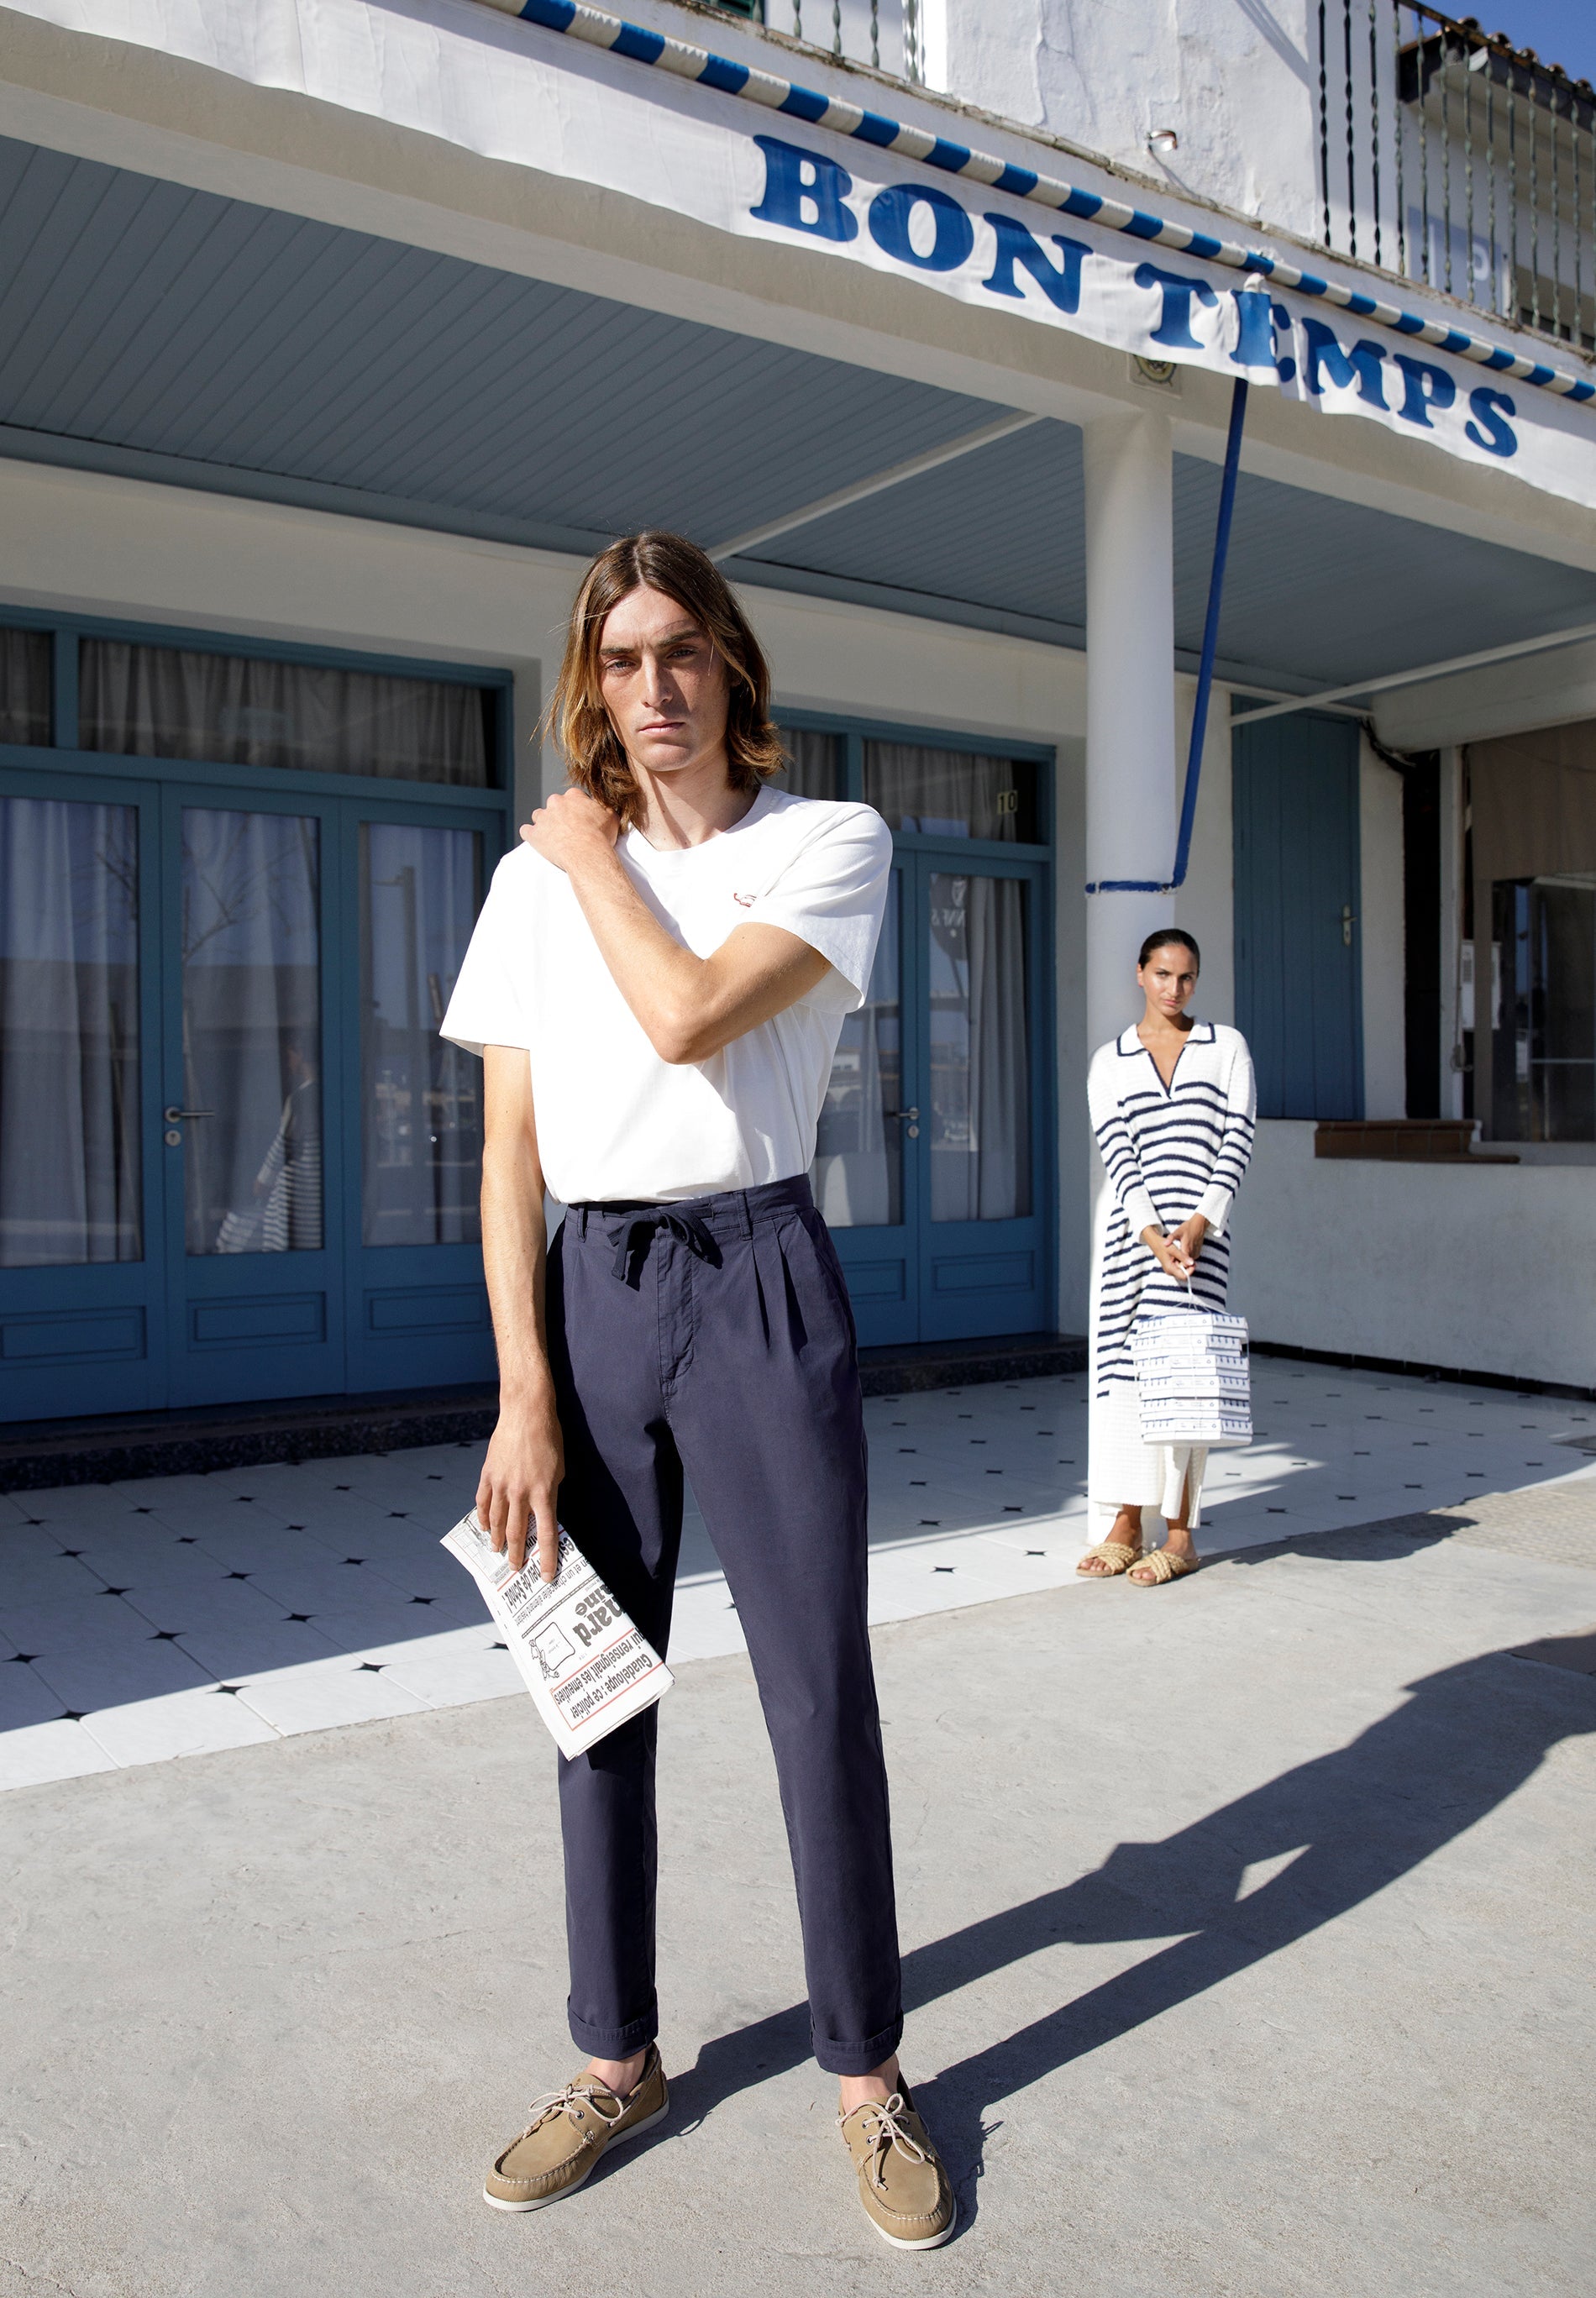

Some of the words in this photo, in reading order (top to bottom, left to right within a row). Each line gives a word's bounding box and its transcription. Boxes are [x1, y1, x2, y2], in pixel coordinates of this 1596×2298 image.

[750, 135, 1093, 314] BON
[1134, 263, 1518, 458] TEMPS
[1000, 792, 1017, 812] 10
[519, 1573, 533, 1593] de
[566, 1570, 575, 1578] un
[503, 1579, 527, 1609] Scholz
[543, 1576, 566, 1599] chancelier
[591, 1640, 633, 1678] renseignait
[581, 1670, 596, 1683] les
[605, 1654, 652, 1692] Guadeloupe
[554, 1678, 585, 1704] émeutiers
[592, 1689, 603, 1702] ce
[570, 1692, 595, 1718] policier
